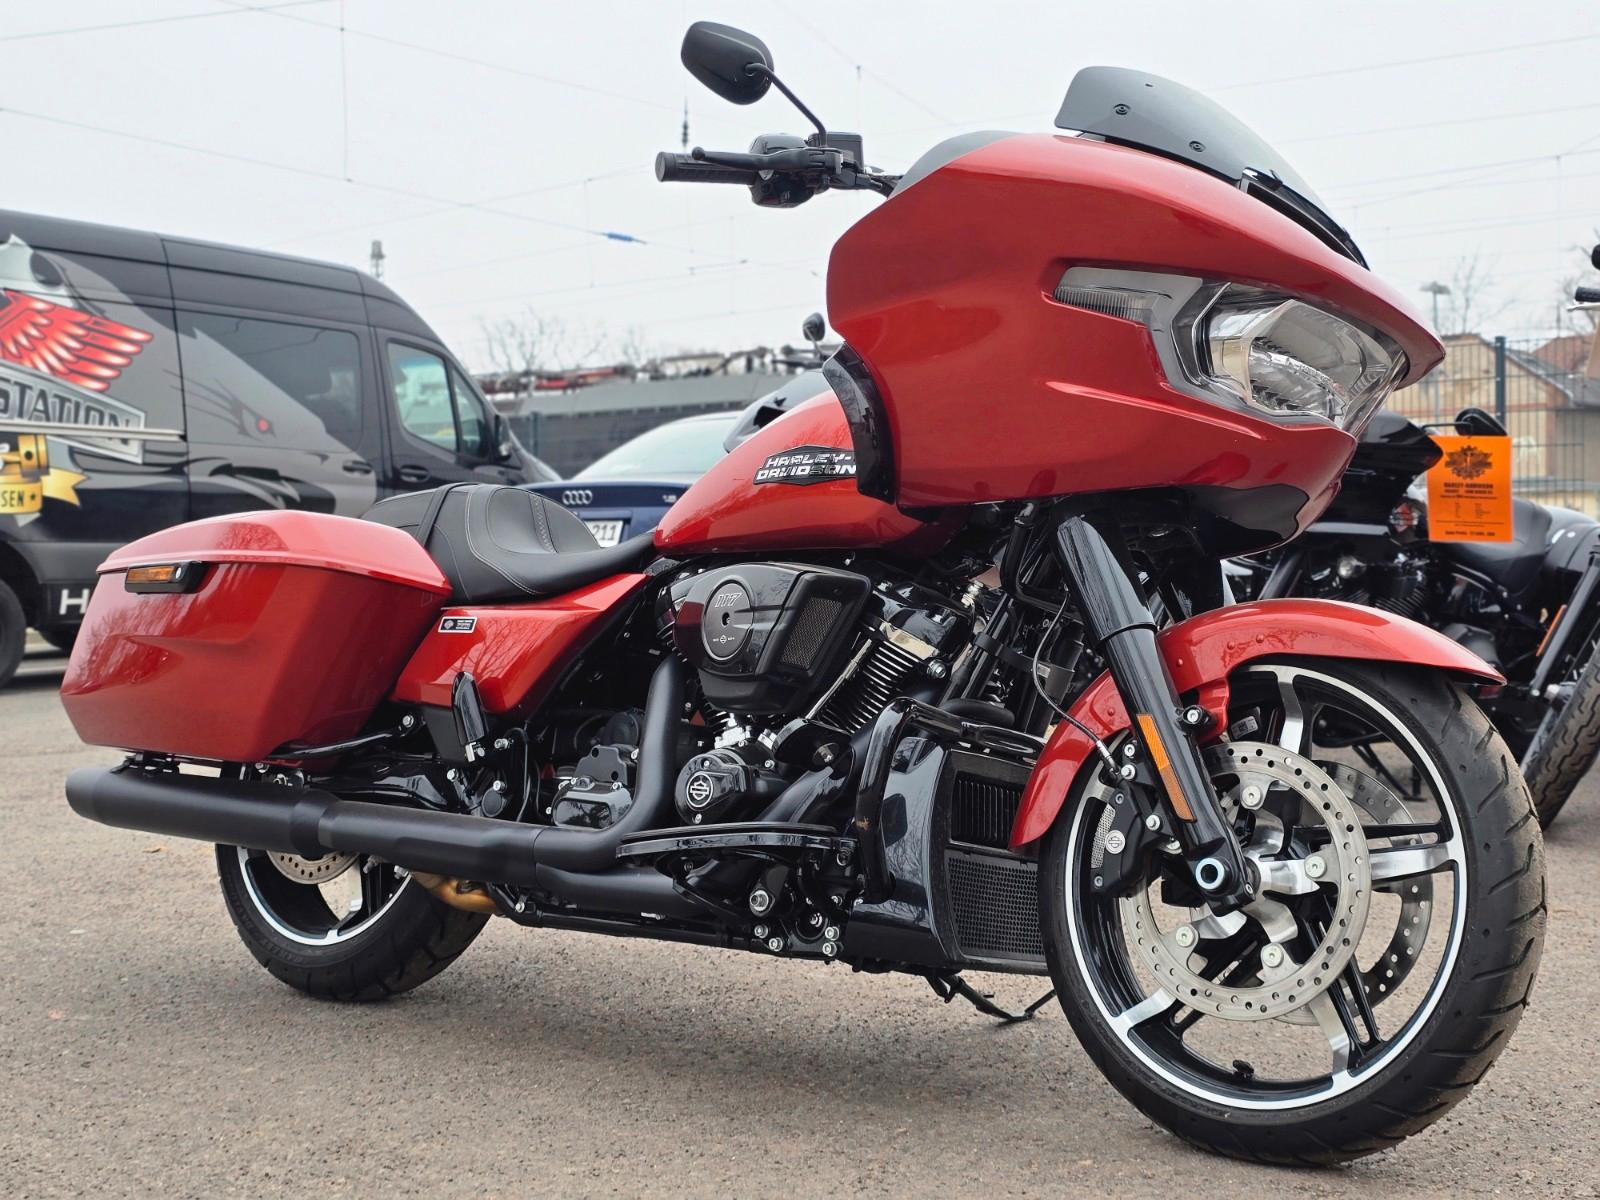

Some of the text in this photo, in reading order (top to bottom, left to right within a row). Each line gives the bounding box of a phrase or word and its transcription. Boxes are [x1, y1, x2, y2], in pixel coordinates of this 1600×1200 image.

[766, 453, 852, 468] HARLEY-
[757, 465, 856, 480] DAVIDSON
[1, 490, 25, 508] SEN
[592, 524, 617, 541] 211
[59, 588, 90, 615] H
[715, 593, 742, 608] 117
